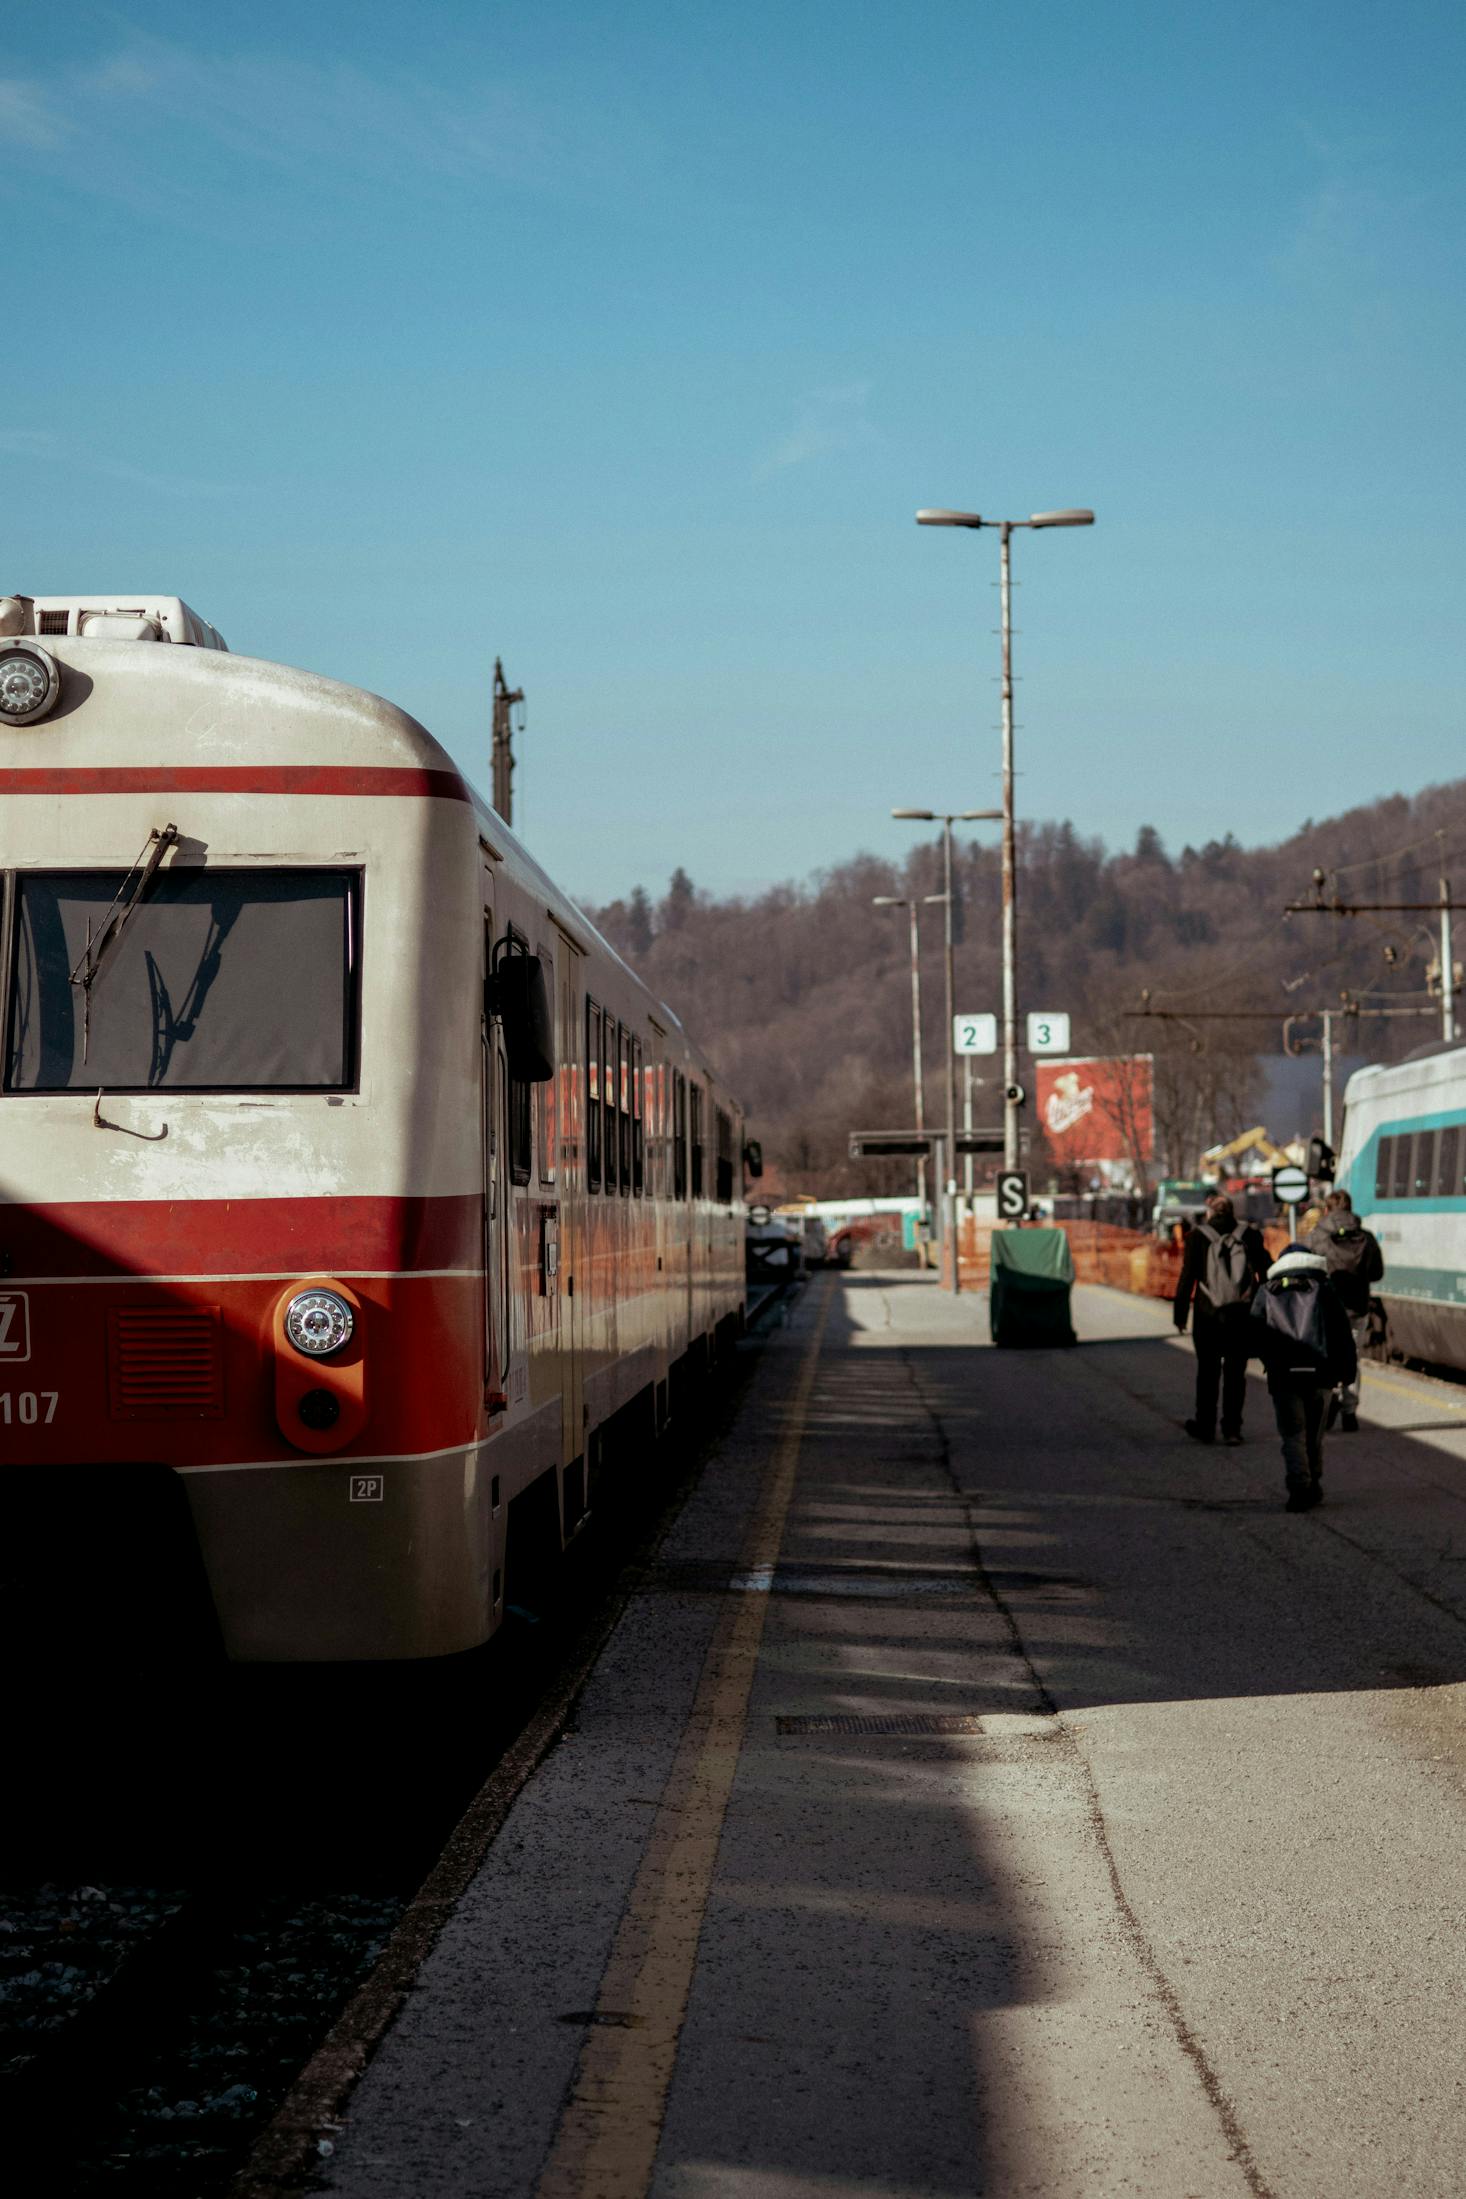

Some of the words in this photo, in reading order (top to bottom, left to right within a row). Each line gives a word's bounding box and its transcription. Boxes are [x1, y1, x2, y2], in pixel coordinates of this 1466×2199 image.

[963, 1026, 977, 1046] 2
[1037, 1024, 1051, 1045] 3
[1002, 1176, 1024, 1215] S
[0, 1391, 59, 1424] 107
[357, 1480, 377, 1497] 2P
